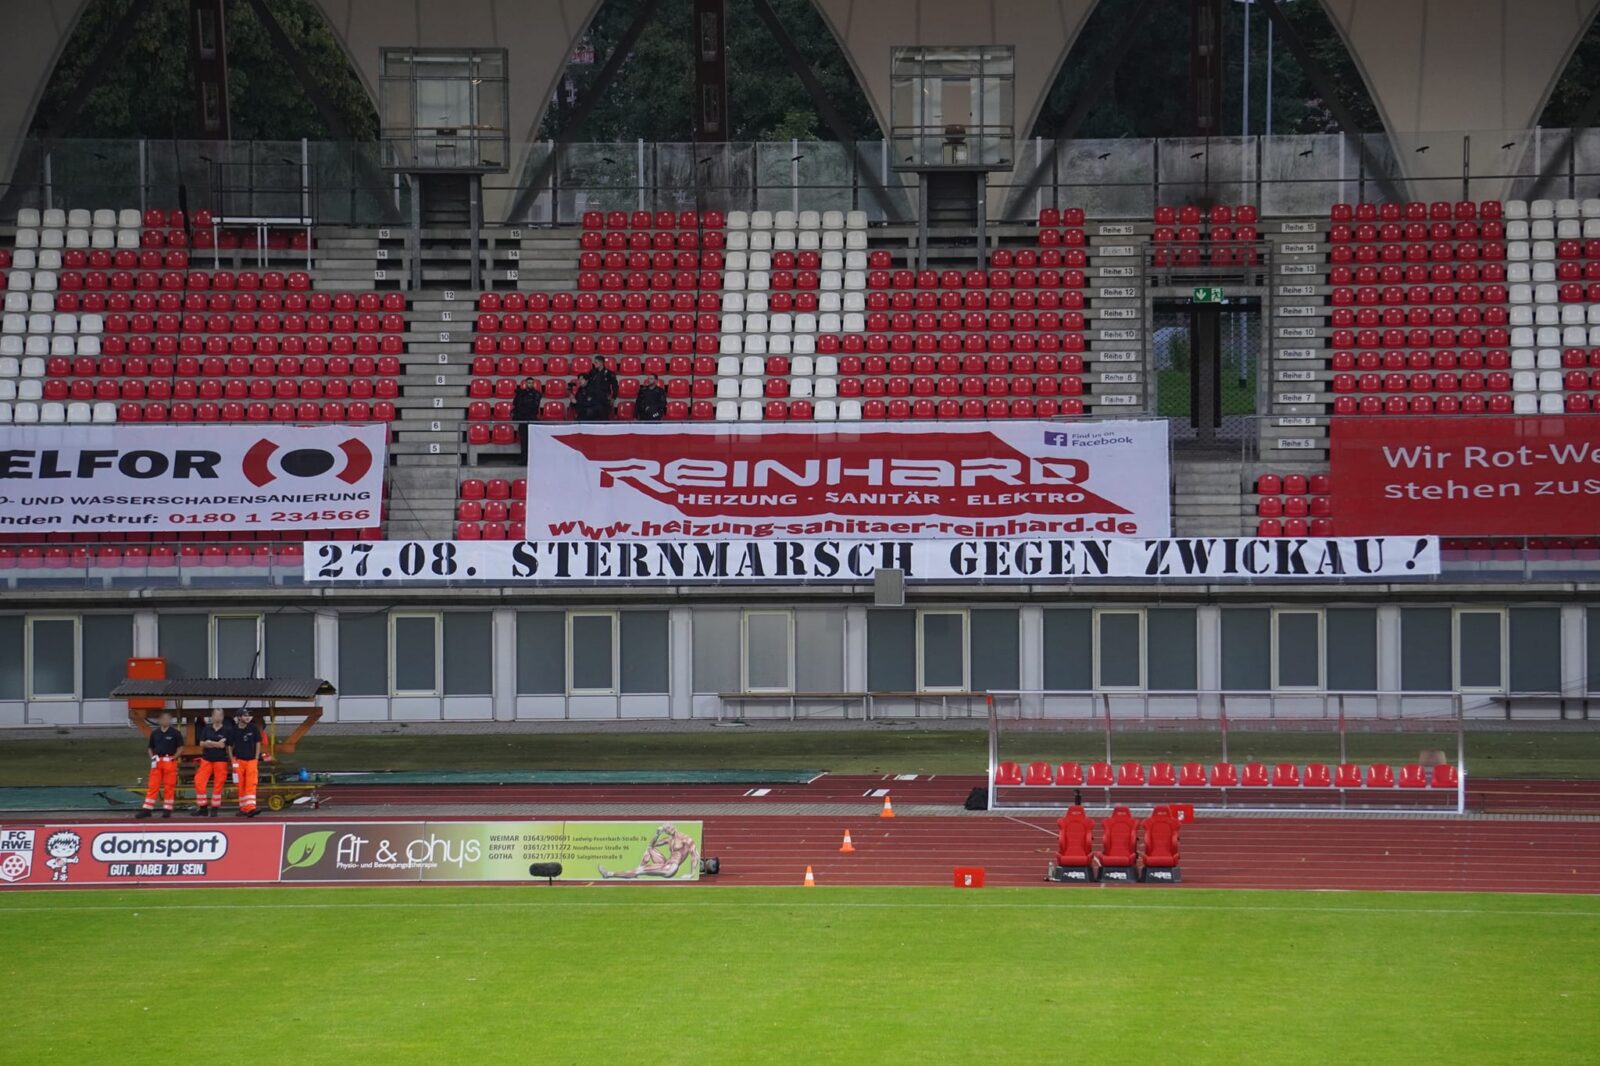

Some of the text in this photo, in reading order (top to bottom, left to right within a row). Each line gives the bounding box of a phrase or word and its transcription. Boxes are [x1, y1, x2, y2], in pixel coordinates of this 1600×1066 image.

[1072, 436, 1133, 447] Facebook
[0, 449, 221, 479] ELFOR
[1382, 445, 1451, 469] Wir
[21, 496, 64, 506] UND
[71, 491, 371, 506] WASSERSCHADENSANIERUNG
[677, 490, 1085, 506] HEIZUNG SANITÄR ELEKTRO
[1384, 480, 1520, 500] stehen
[72, 513, 159, 525] Notruf:
[169, 513, 236, 524] 0180
[245, 513, 261, 523] 1
[270, 510, 370, 522] 234566
[548, 517, 1137, 540] www.heizung-sanitaer-reinhard.de
[318, 538, 1428, 578] 27.08. STERNMARSCH GEGEN ZWICKAU !
[8, 831, 26, 840] FC
[1, 840, 32, 850] RWE
[100, 835, 219, 857] domsport
[376, 840, 397, 863] &
[135, 863, 162, 875] DABEI
[166, 863, 178, 875] ZU
